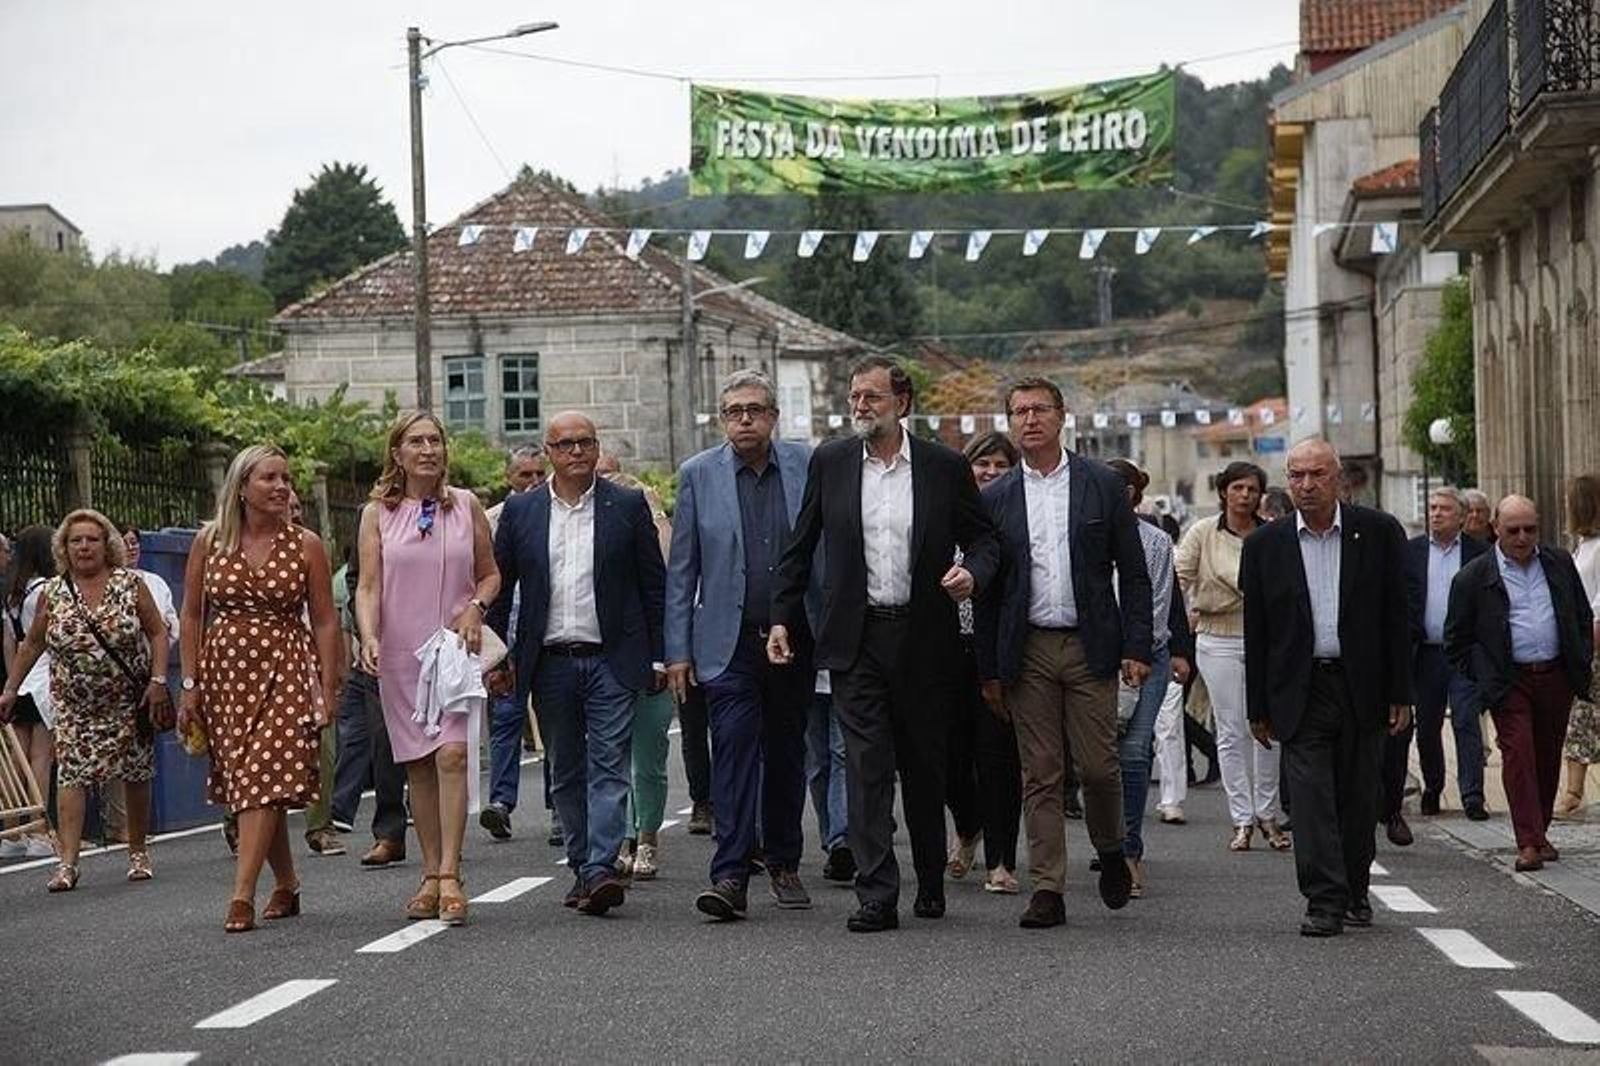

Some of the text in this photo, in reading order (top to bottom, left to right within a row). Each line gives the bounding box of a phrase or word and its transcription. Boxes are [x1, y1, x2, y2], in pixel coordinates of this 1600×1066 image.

[716, 107, 1147, 160] FESTA DA VENDIMA DE LEIRO
